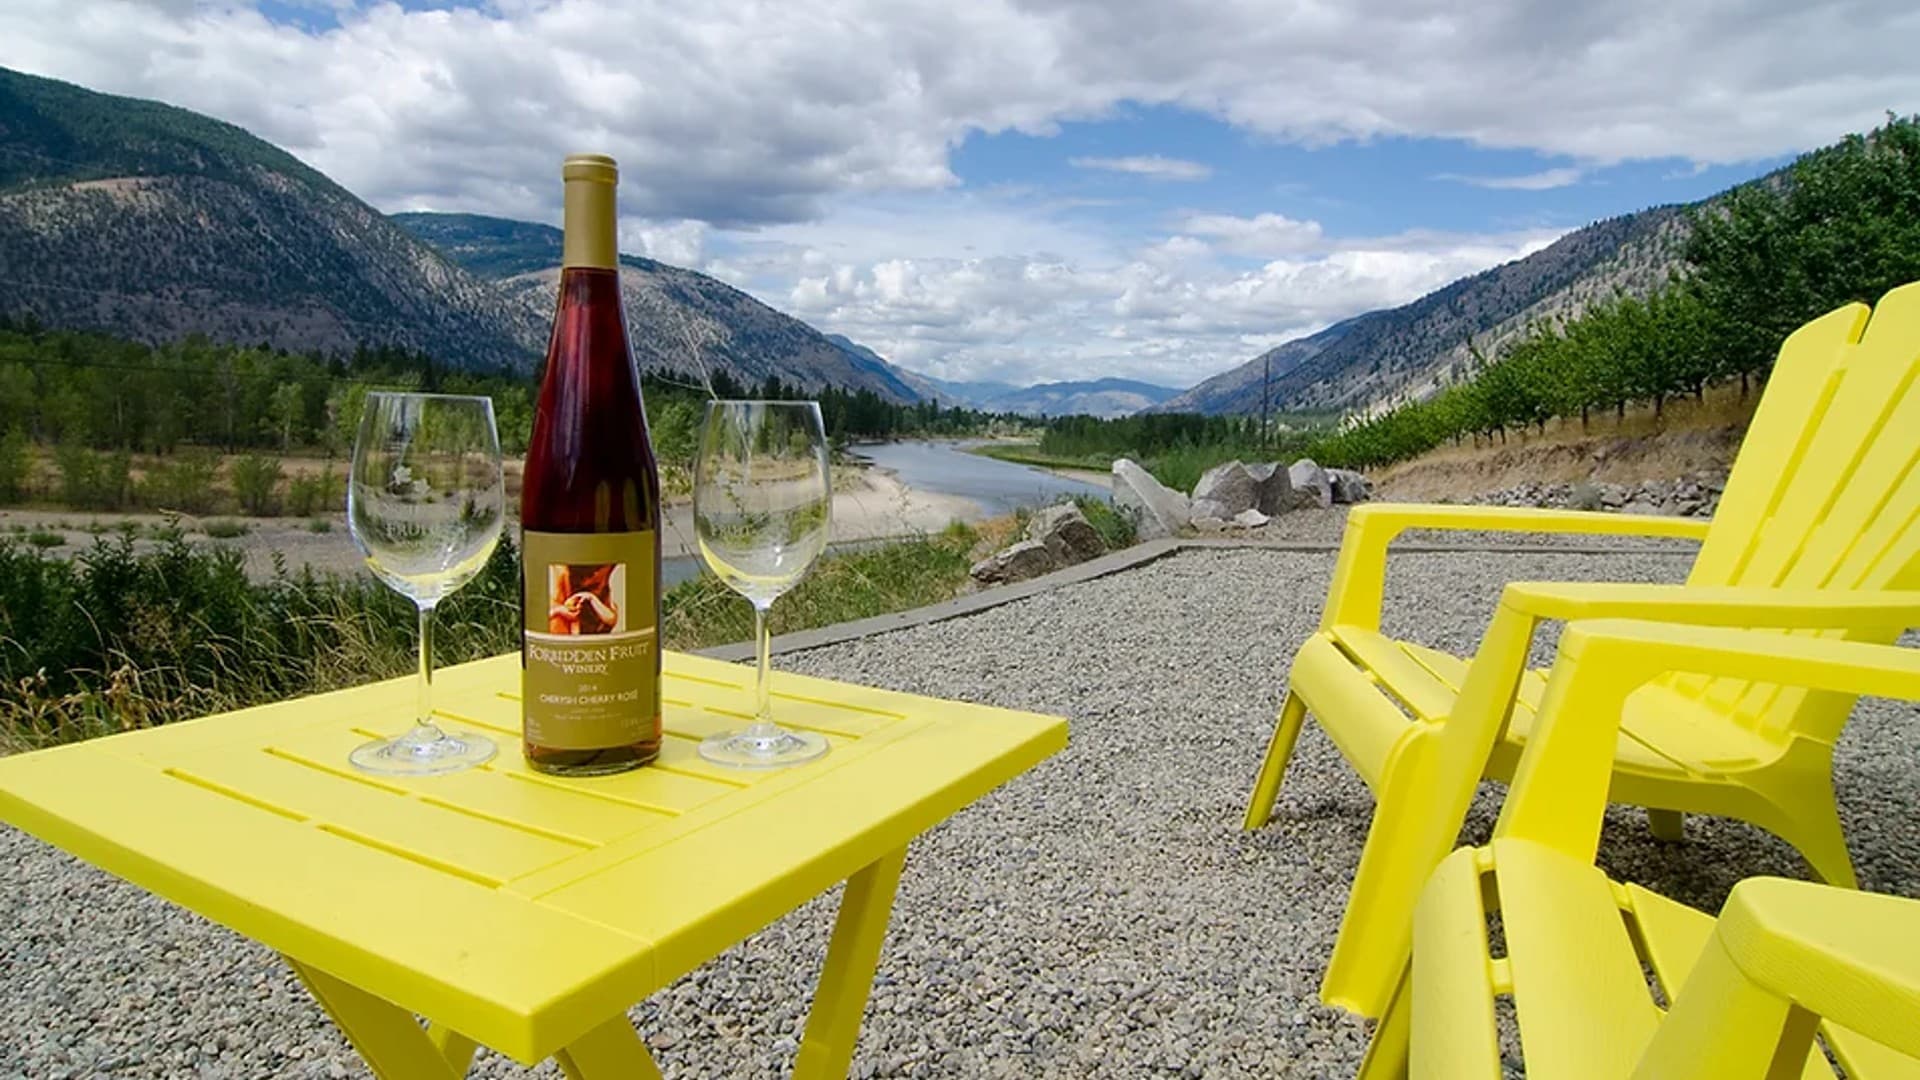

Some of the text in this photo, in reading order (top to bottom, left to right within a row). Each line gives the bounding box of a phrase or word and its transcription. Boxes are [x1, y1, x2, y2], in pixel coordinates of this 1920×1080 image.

[529, 642, 649, 665] FORBIDDEN FRUIT
[563, 663, 609, 675] WINERY
